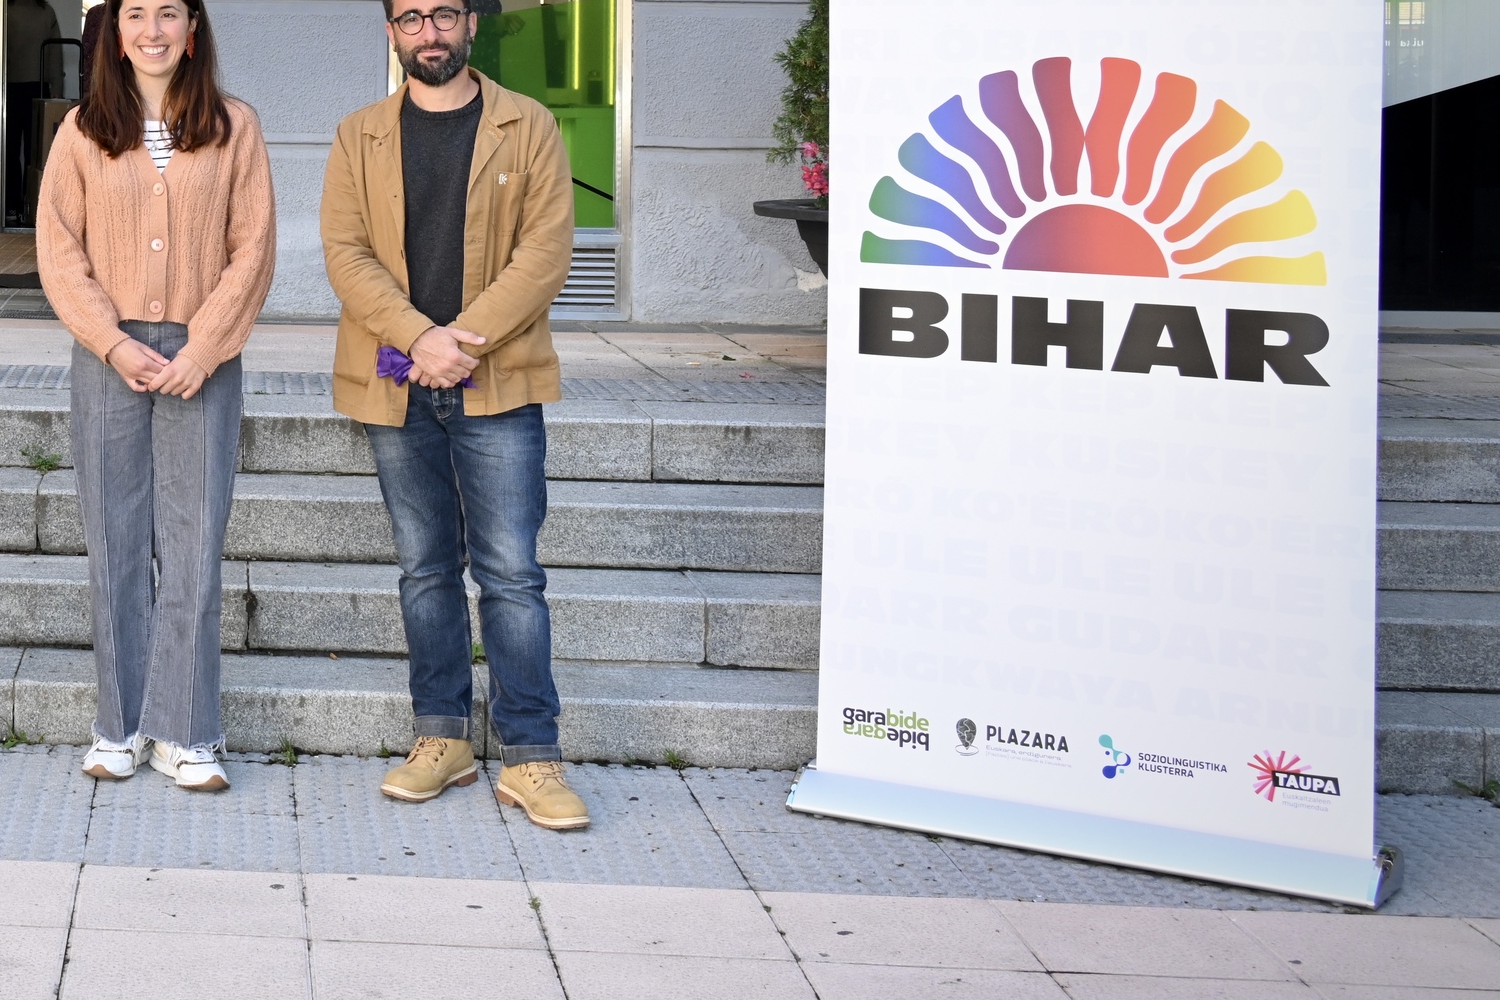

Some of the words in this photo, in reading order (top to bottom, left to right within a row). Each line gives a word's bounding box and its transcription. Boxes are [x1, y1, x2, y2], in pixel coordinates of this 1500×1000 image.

[859, 287, 1331, 387] BIHAR
[843, 707, 929, 731] garabide
[986, 725, 1069, 753] PLAZARA
[1138, 752, 1227, 773] SOZIOLINGUISTIKA
[1138, 763, 1194, 778] KLUSTERRA
[1275, 772, 1337, 794] TAUPA
[1282, 801, 1329, 812] mugimendua
[1283, 792, 1331, 805] Euskaltzaleen
